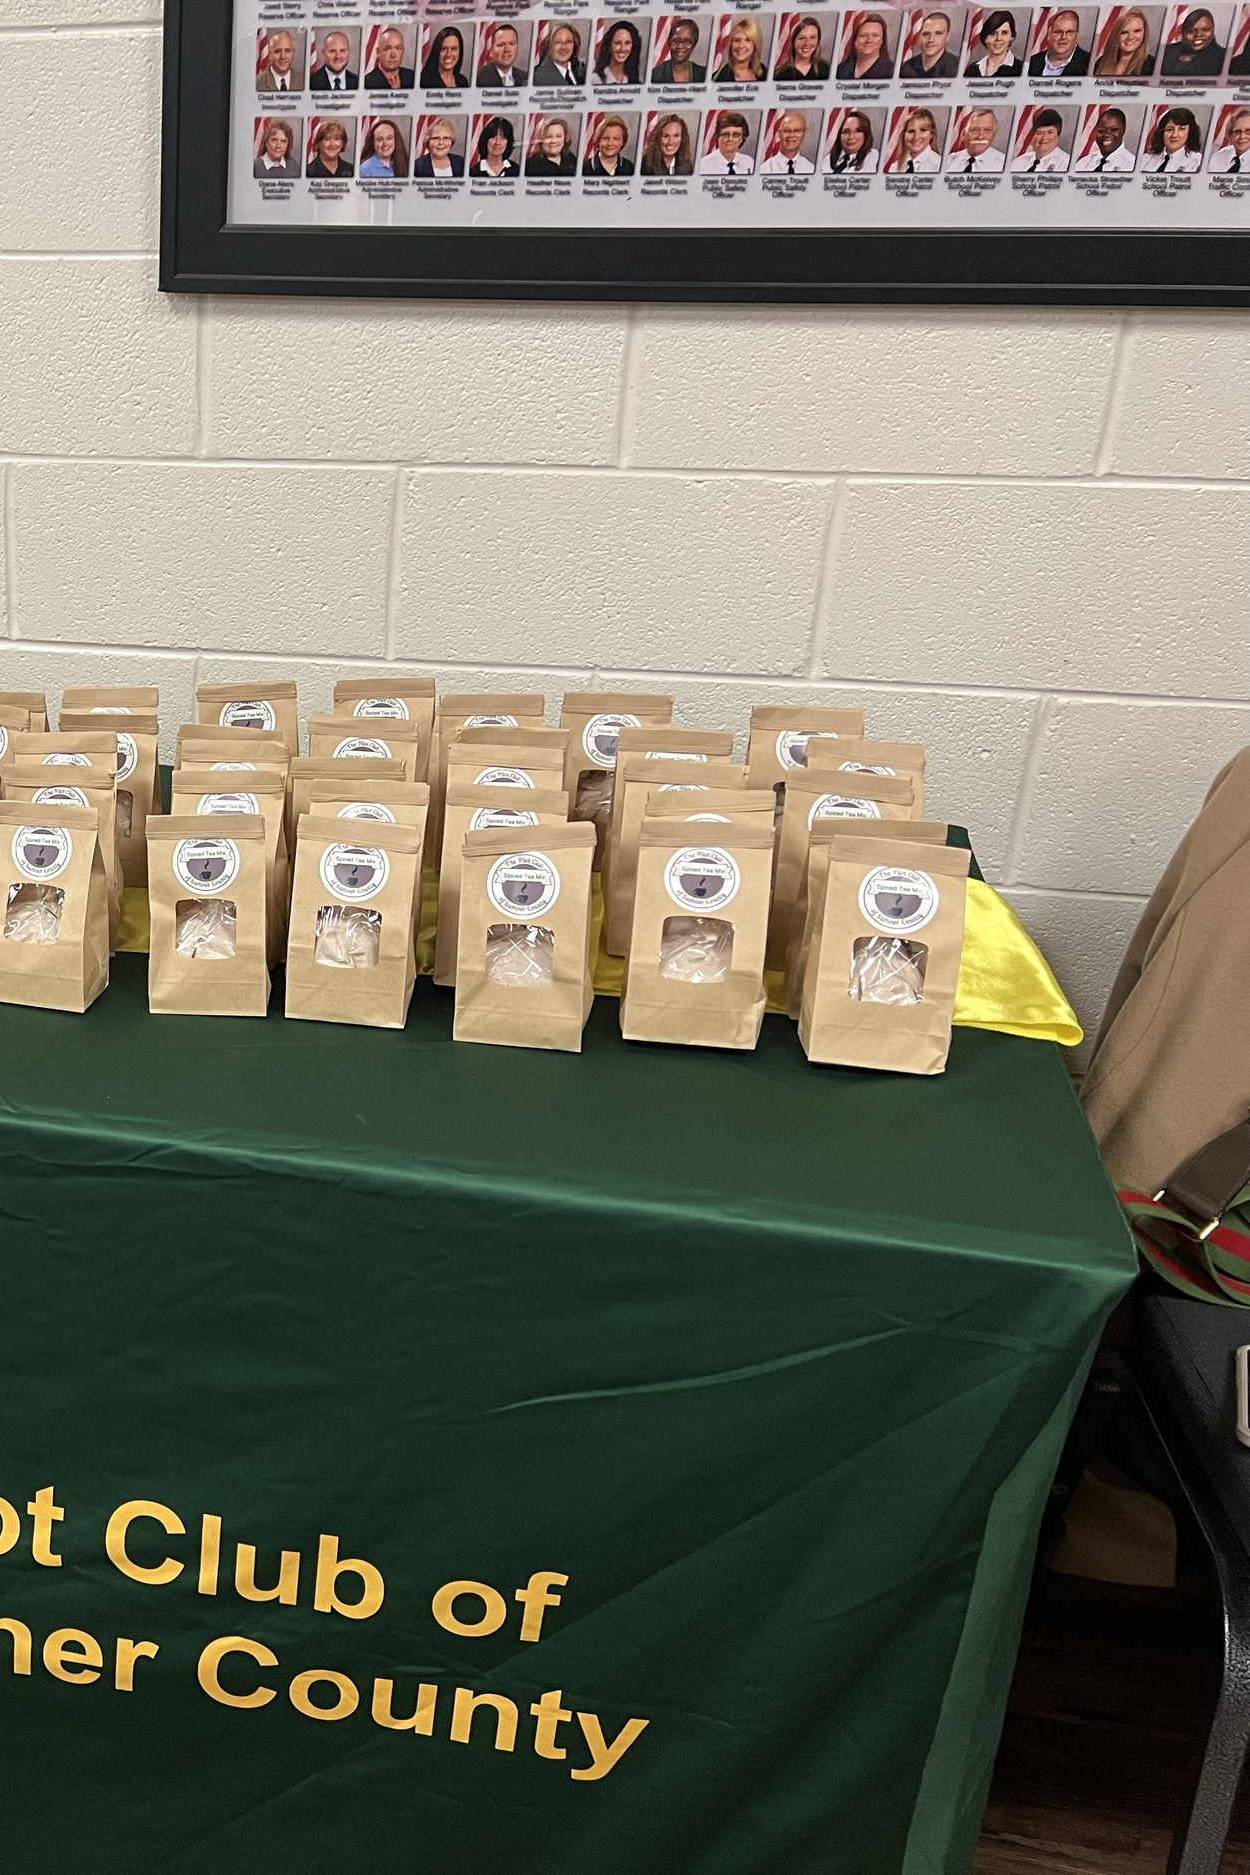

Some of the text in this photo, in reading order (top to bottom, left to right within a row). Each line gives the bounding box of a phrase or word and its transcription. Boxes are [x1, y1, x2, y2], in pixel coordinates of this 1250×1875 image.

[104, 1499, 385, 1620] Club
[432, 1572, 568, 1643] of
[197, 1636, 649, 1780] County
